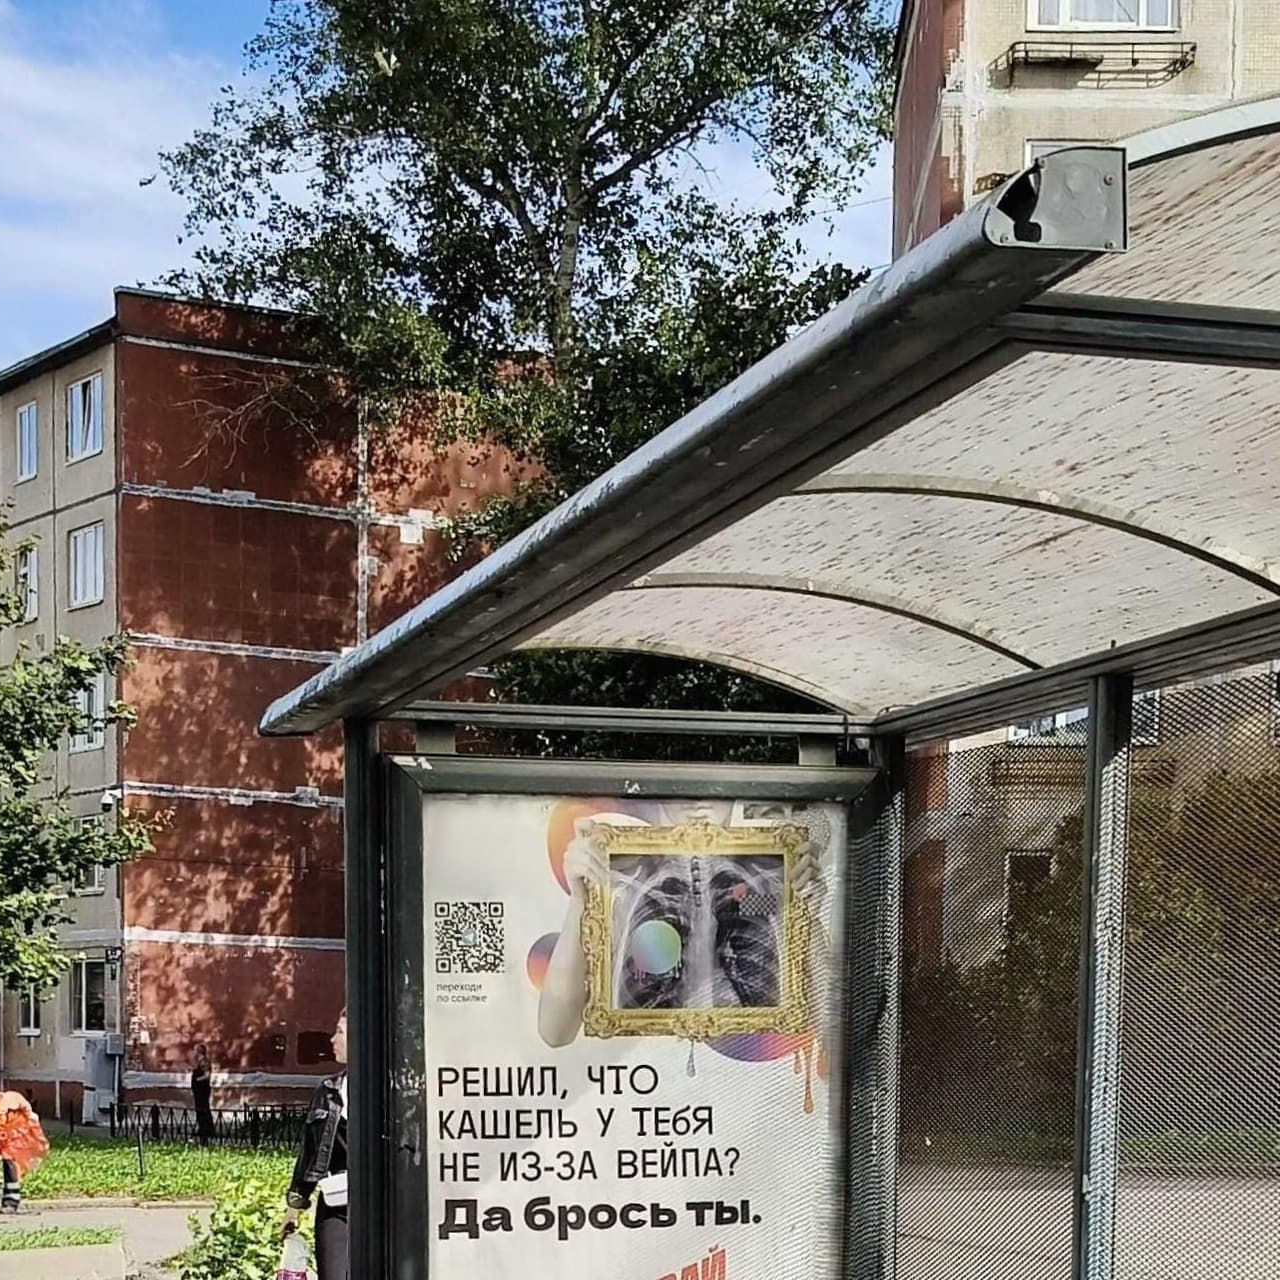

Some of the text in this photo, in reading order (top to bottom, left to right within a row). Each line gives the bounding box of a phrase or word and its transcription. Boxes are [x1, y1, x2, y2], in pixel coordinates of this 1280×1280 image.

[436, 983, 482, 993] переходи
[438, 1064, 659, 1100] РЕШИЛ, ЧТО
[438, 1109, 578, 1140] КАШЕЛЬ
[596, 1108, 615, 1137] У
[439, 1141, 741, 1182] НЕ ИЗ-ЗА ВЕЙПА?
[438, 1196, 762, 1240] Да брось ты.
